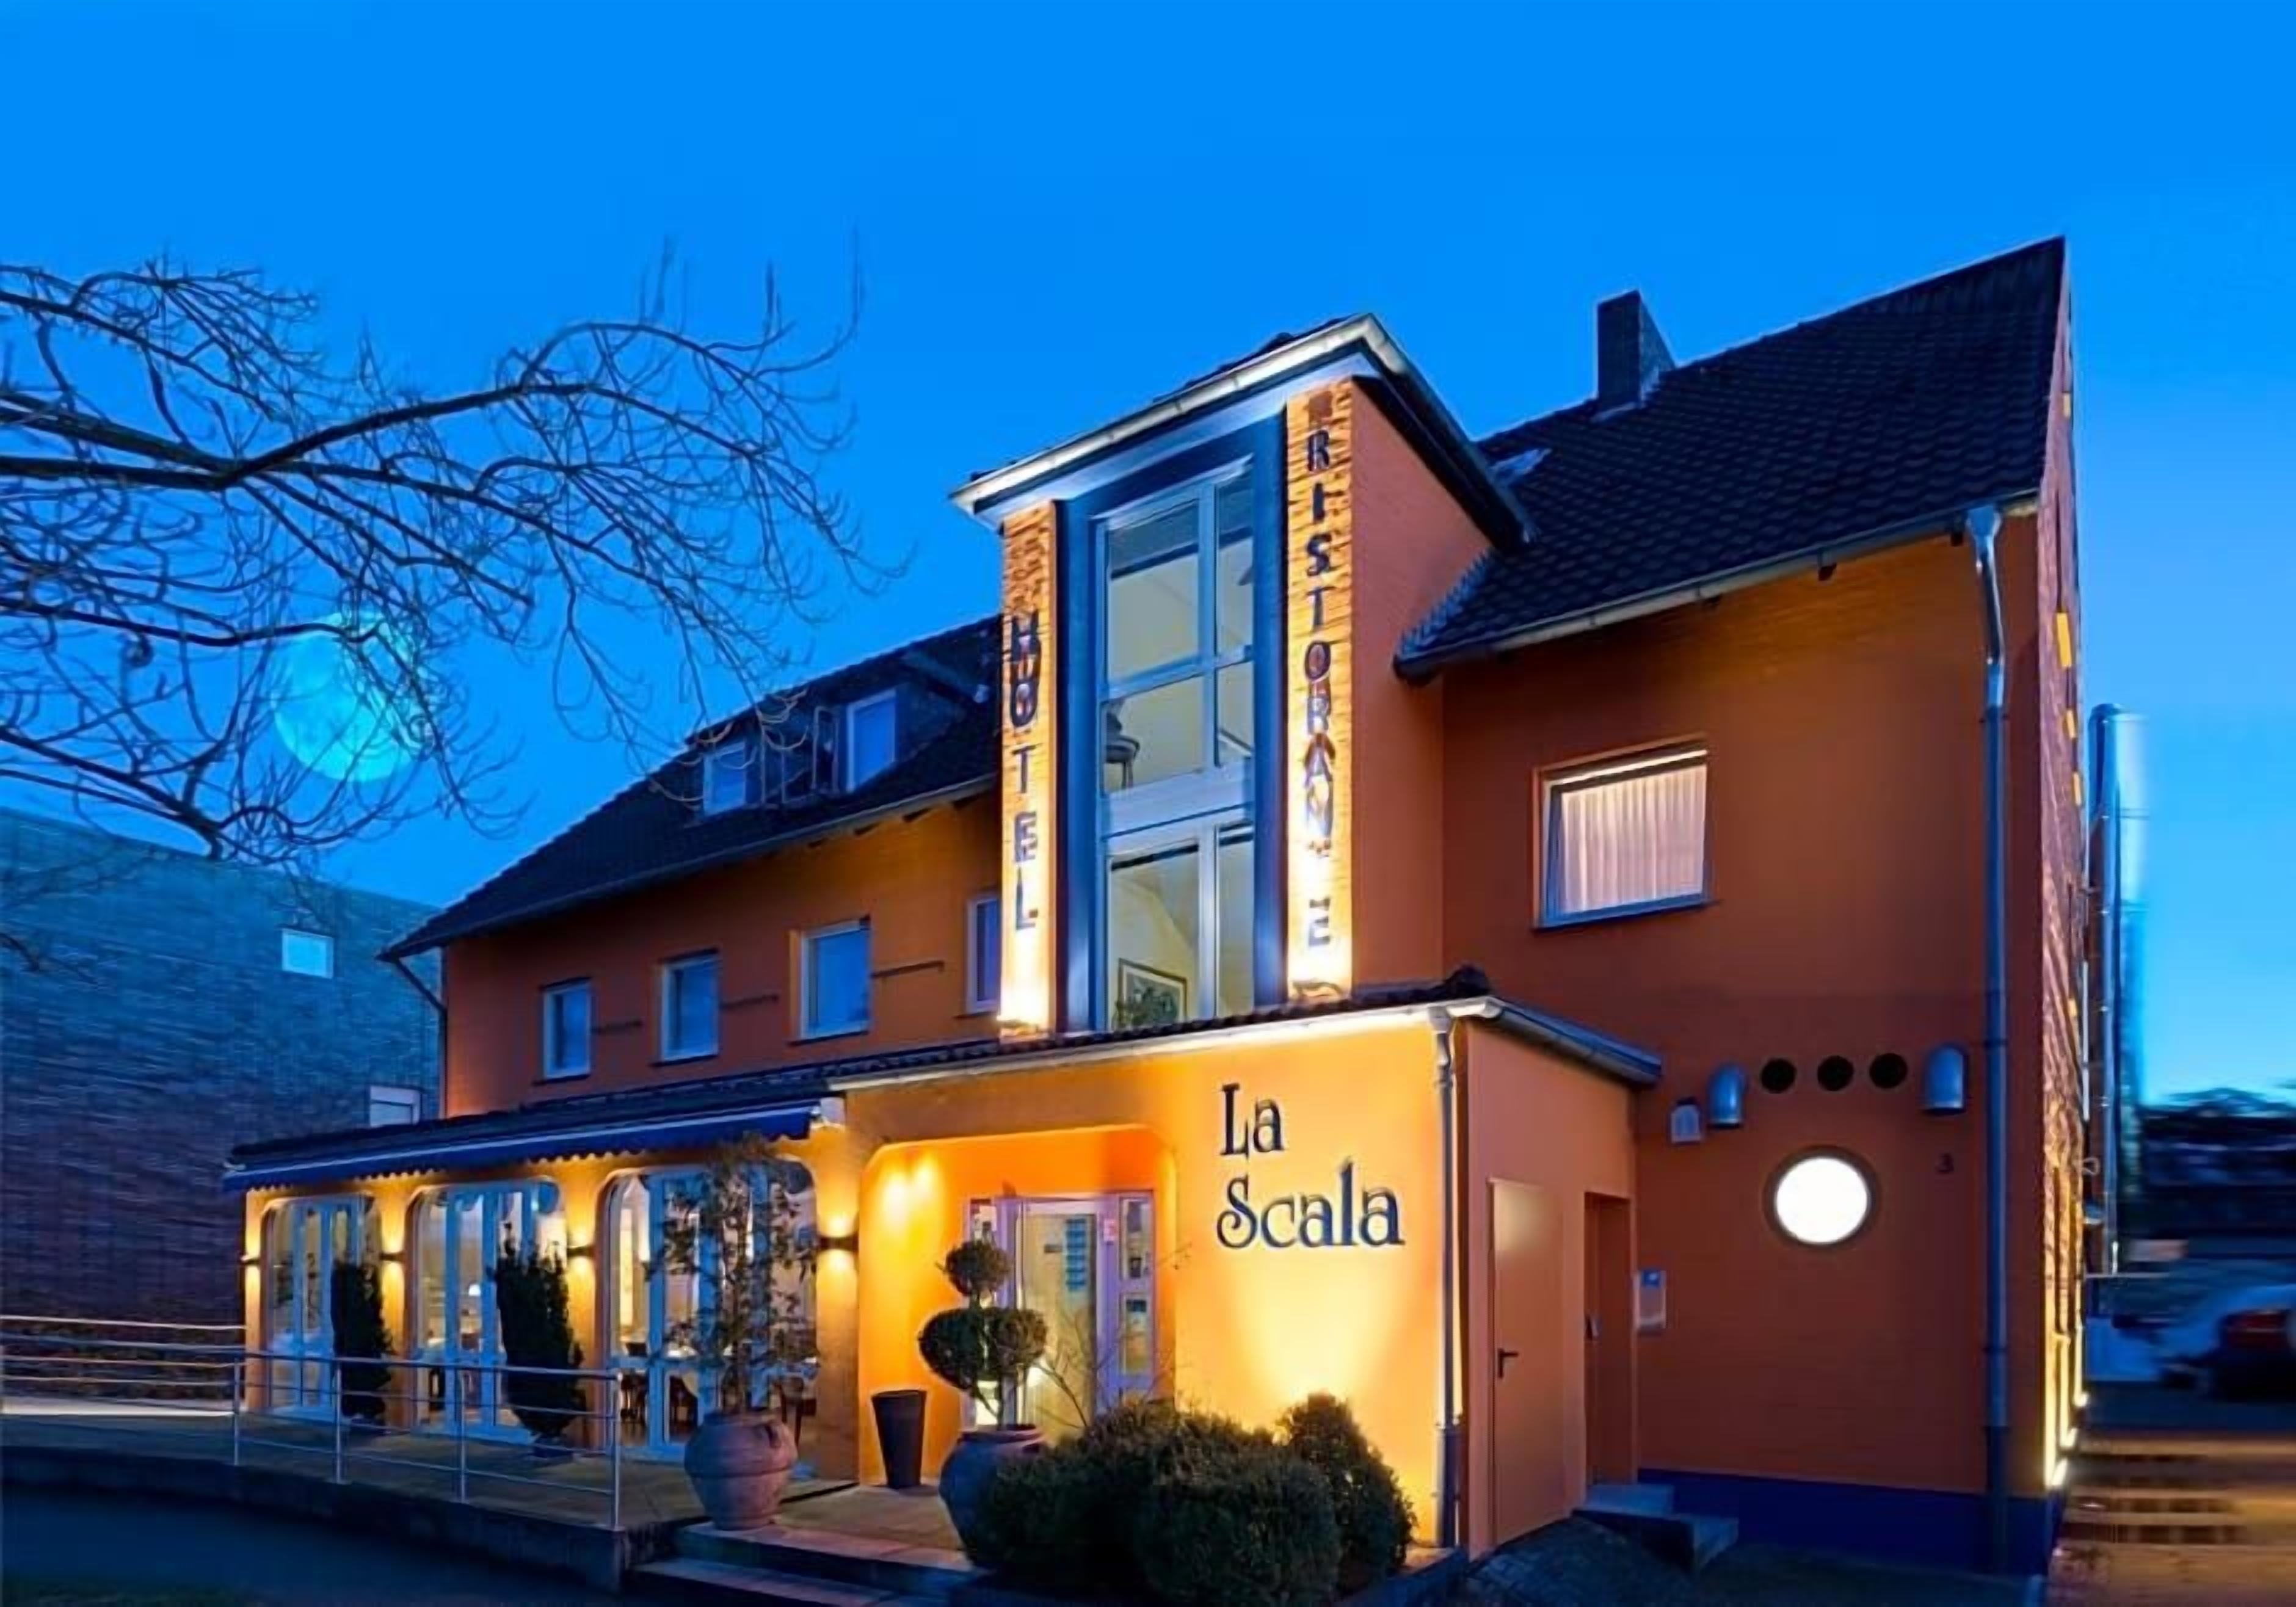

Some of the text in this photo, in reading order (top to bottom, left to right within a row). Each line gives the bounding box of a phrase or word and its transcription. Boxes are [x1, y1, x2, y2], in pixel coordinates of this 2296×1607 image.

[1010, 611, 1039, 930] HOTEL
[1304, 429, 1336, 947] RISTORANE
[1217, 1156, 1405, 1249] Scala
[1220, 1083, 1285, 1158] La
